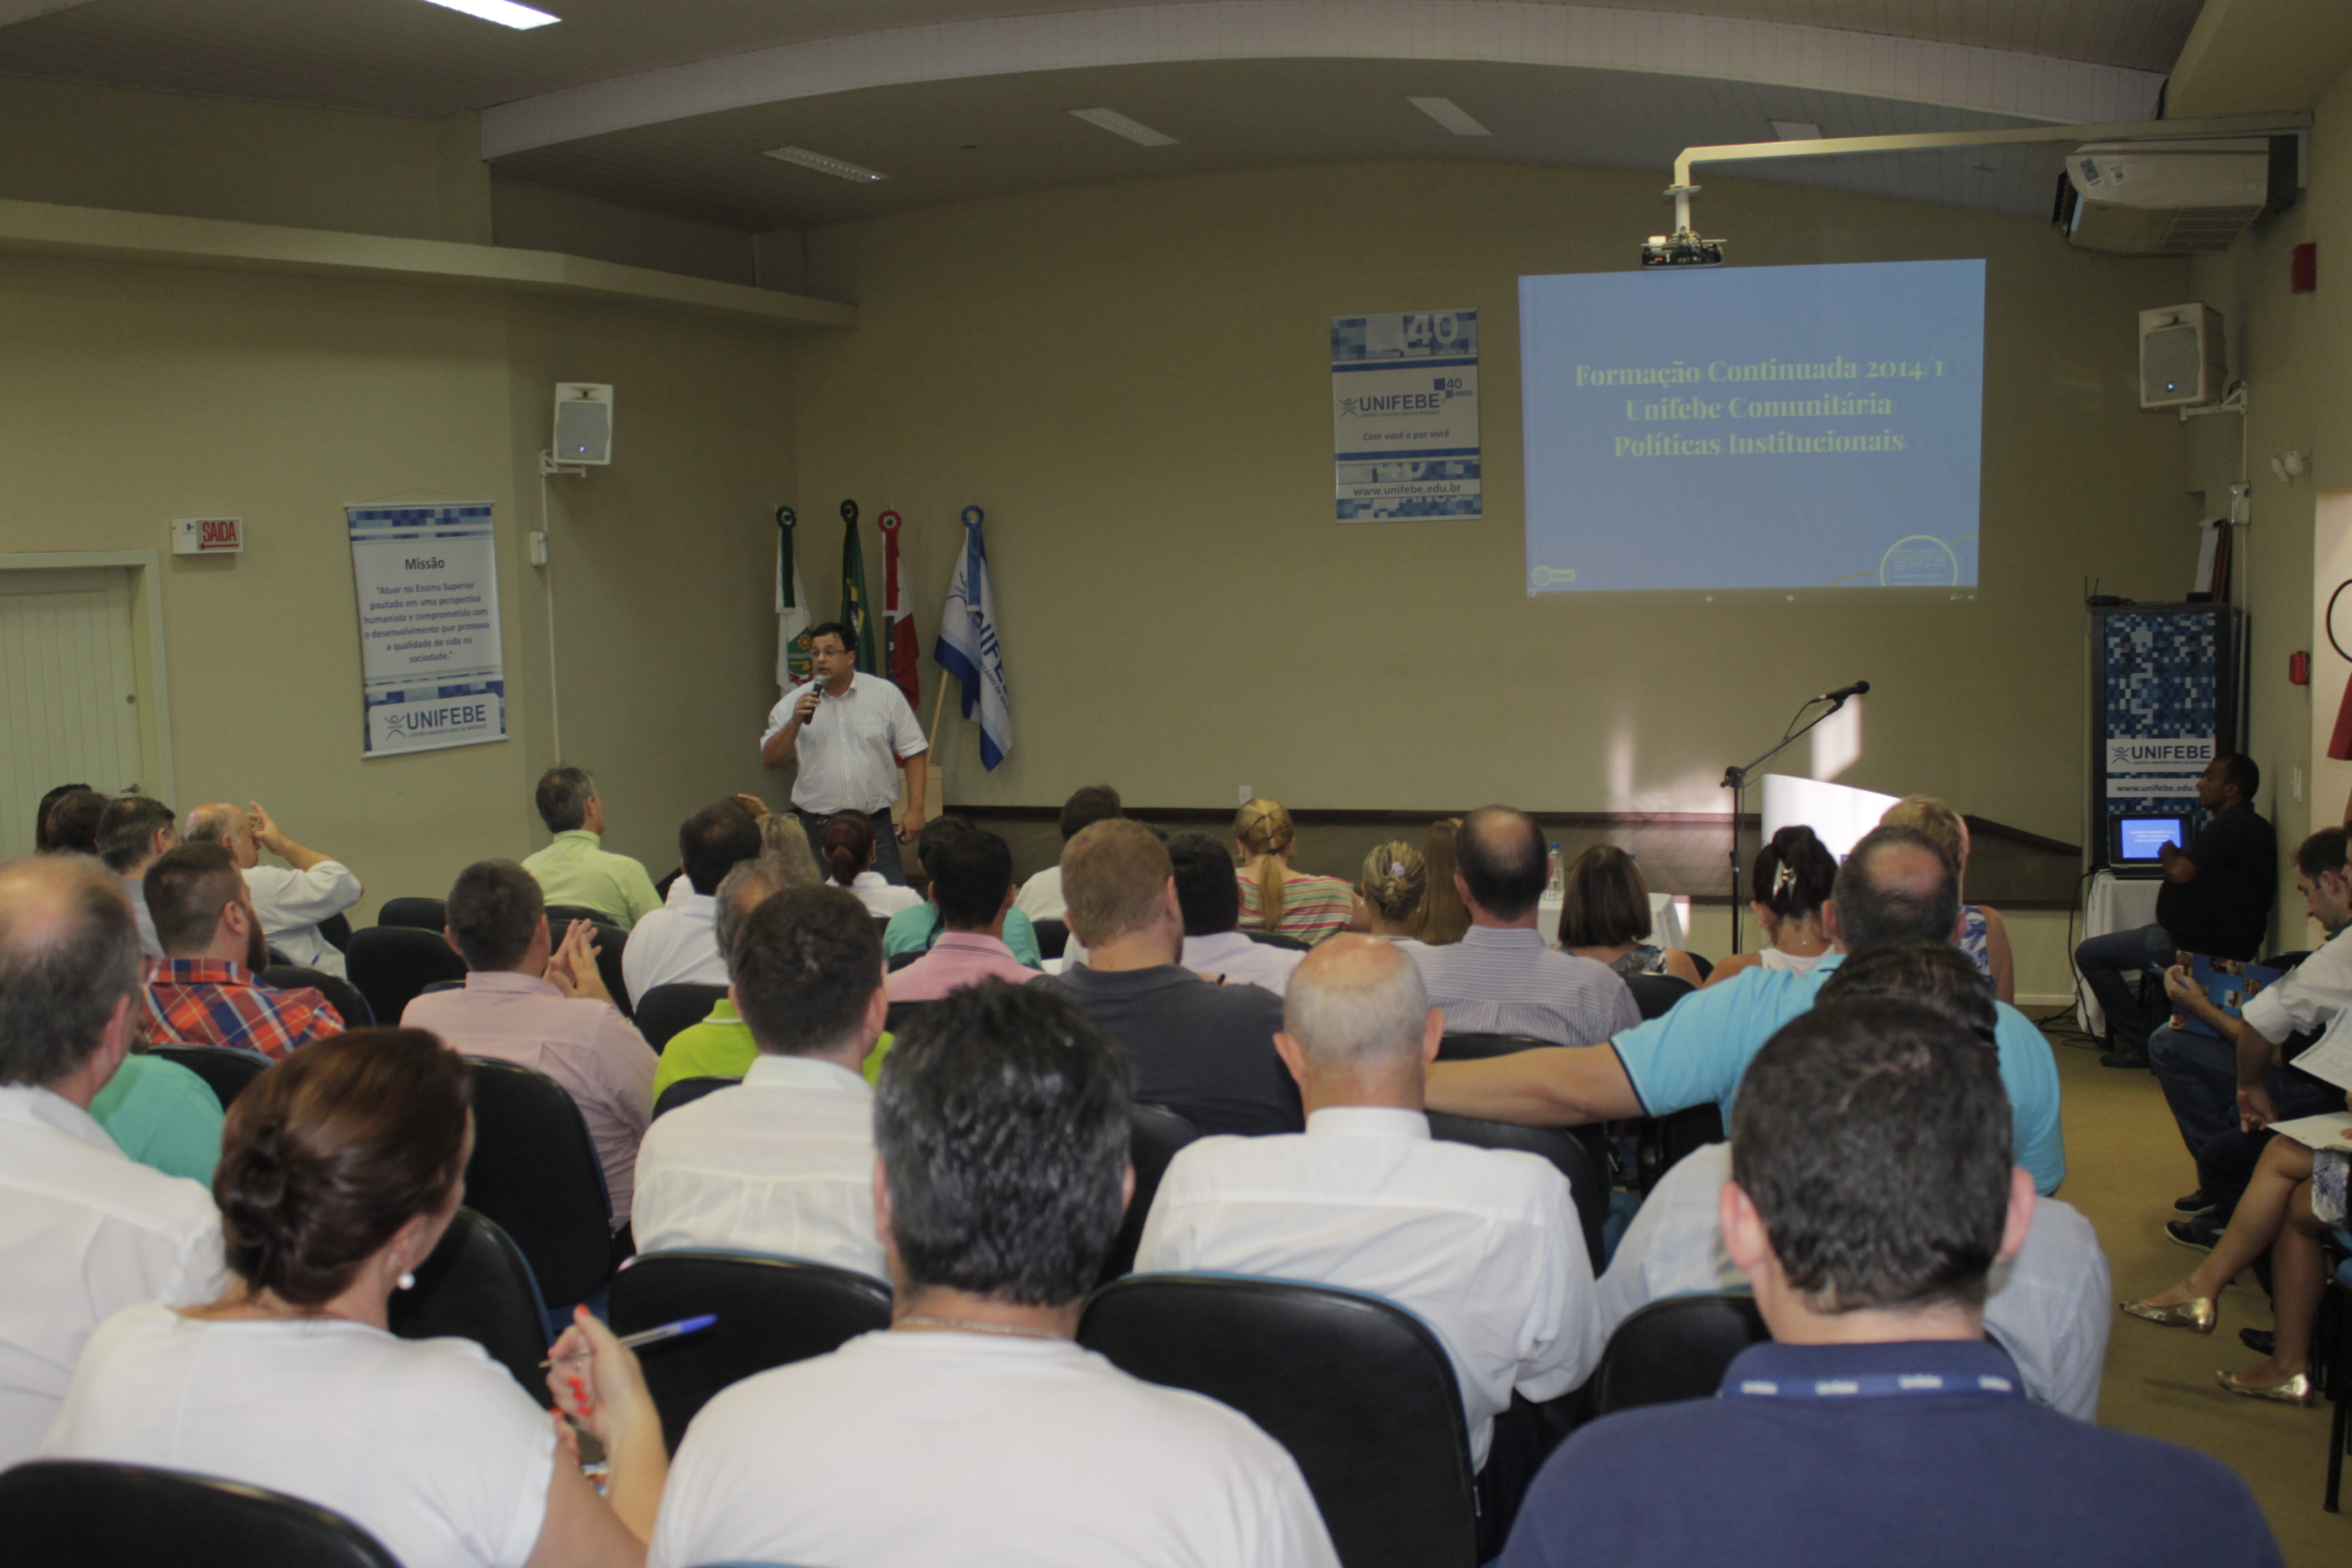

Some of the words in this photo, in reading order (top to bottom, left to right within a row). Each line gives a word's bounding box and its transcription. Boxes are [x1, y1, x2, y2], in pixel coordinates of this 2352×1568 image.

[1575, 360, 1700, 389] Formação
[1708, 356, 1858, 382] Continuada
[1865, 355, 1943, 381] 2014/1
[1446, 378, 1463, 389] 40
[1359, 393, 1440, 412] UNIFEBE
[1625, 396, 1722, 421] Unifebe
[1728, 391, 1892, 418] Comunitária
[1363, 432, 1382, 441] Com
[1384, 431, 1403, 440] você
[1413, 432, 1428, 440] por
[1430, 429, 1450, 438] você
[1614, 432, 1722, 458] Políticas
[1729, 428, 1905, 455] Institucionais
[1353, 482, 1462, 496] www.unifebe.edu.br
[405, 557, 445, 570] Missão
[416, 584, 441, 593] Ensino
[443, 581, 475, 592] Superior
[369, 599, 404, 612] pautado
[439, 595, 481, 607] perspectiva
[364, 615, 407, 624] humanista
[415, 609, 471, 620] comprometido
[372, 627, 439, 639] desenvolvimento
[441, 624, 456, 633] que
[457, 622, 490, 633] promova
[393, 640, 432, 652] qualidade
[434, 639, 444, 647] de
[446, 637, 461, 646] vida
[406, 704, 487, 731] UNIFEBE
[2131, 745, 2212, 760] UNIFEBE
